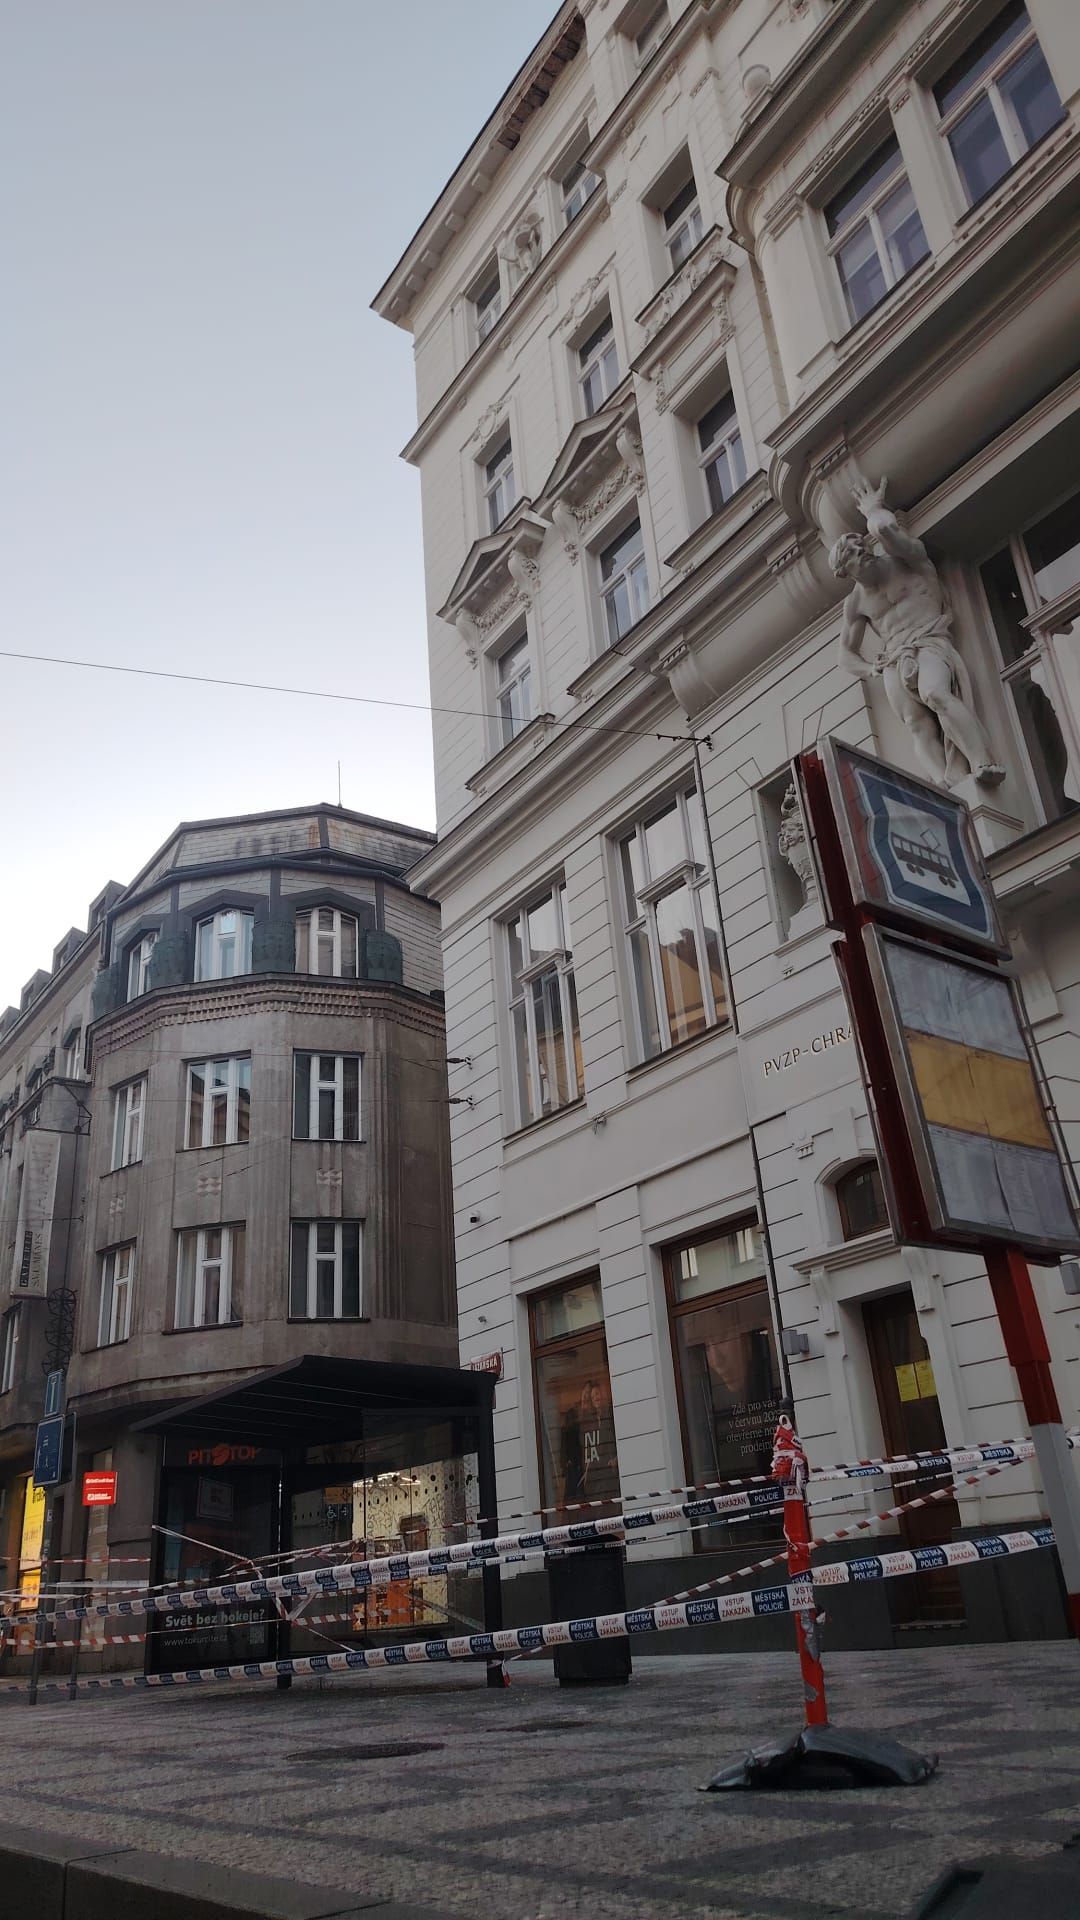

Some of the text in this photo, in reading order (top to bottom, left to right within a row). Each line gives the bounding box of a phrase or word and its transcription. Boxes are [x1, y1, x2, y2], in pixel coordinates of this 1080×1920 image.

[732, 1403, 745, 1416] Zde
[748, 1401, 761, 1412] pro
[726, 1429, 762, 1443] otevřeme
[754, 1492, 779, 1503] POLICIE
[920, 1557, 943, 1569] POLICIE
[724, 1597, 745, 1607] VSTUP
[759, 1601, 784, 1613] POLICIE
[660, 1607, 679, 1617] VSTUP
[691, 1611, 716, 1623] POLICIE
[165, 1614, 193, 1628] Svět
[196, 1613, 218, 1625] bez
[630, 1621, 652, 1633] POLICIE
